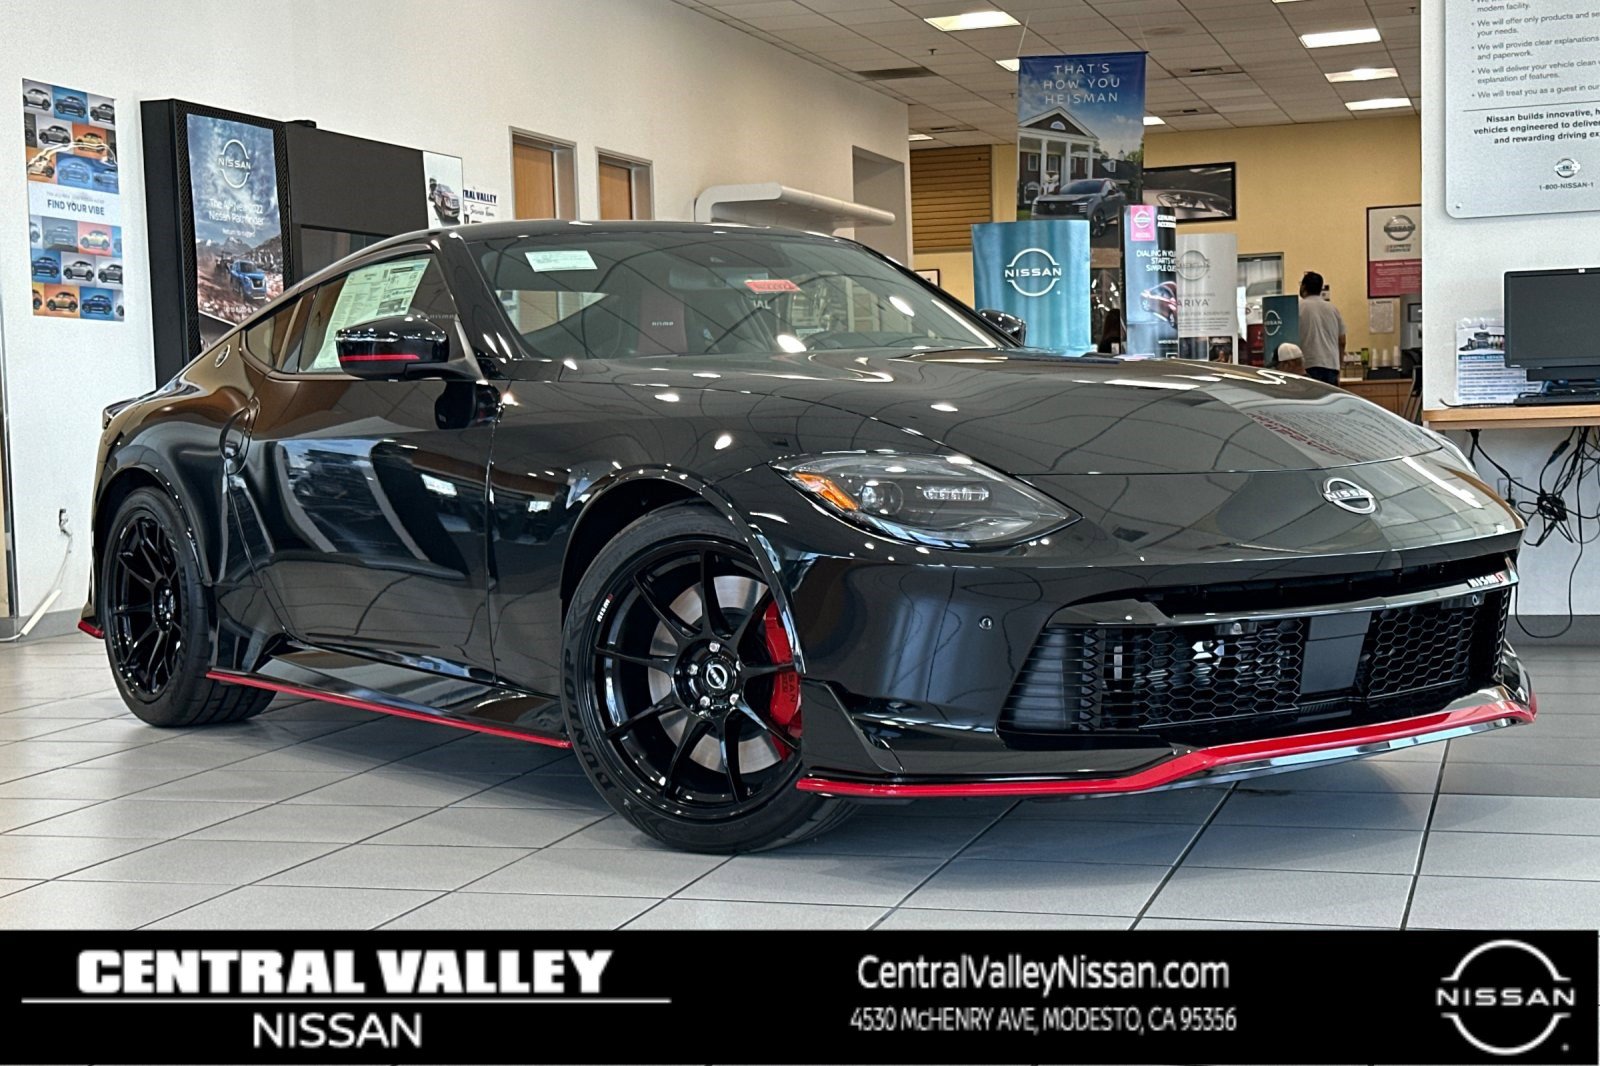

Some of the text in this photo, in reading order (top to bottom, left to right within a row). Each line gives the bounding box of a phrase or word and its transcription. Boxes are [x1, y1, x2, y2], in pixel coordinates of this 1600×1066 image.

[1477, 4, 1505, 12] modern
[1505, 17, 1522, 25] offer
[1524, 16, 1539, 24] only
[1541, 13, 1573, 23] products
[1477, 30, 1492, 38] your
[1505, 40, 1533, 50] provide
[1554, 36, 1599, 46] explanations
[1054, 63, 1110, 75] THAT'S
[1505, 64, 1530, 72] deliver
[1531, 64, 1547, 72] your
[1549, 61, 1574, 69] vehicle
[1043, 78, 1120, 90] HOW YOU
[1477, 75, 1518, 85] explanation
[1524, 88, 1537, 96] you
[1556, 85, 1577, 94] guest
[1045, 92, 1118, 105] HEISMAN
[1486, 115, 1515, 123] Nissan
[1517, 112, 1544, 121] builds
[1546, 108, 1593, 118] innovative,
[1473, 127, 1508, 135] vehicles
[1510, 121, 1559, 133] engineered
[1494, 136, 1510, 144] and
[1512, 132, 1555, 143] rewarding
[1557, 131, 1587, 141] driving
[218, 157, 251, 170] NISSAN
[1539, 181, 1594, 191] 1-800-NISSAN-1
[476, 192, 497, 203] VALLEY
[47, 199, 105, 216] FIND YOUR VIBE
[1005, 267, 1061, 278] NISSAN
[564, 648, 617, 792] DUNLOP
